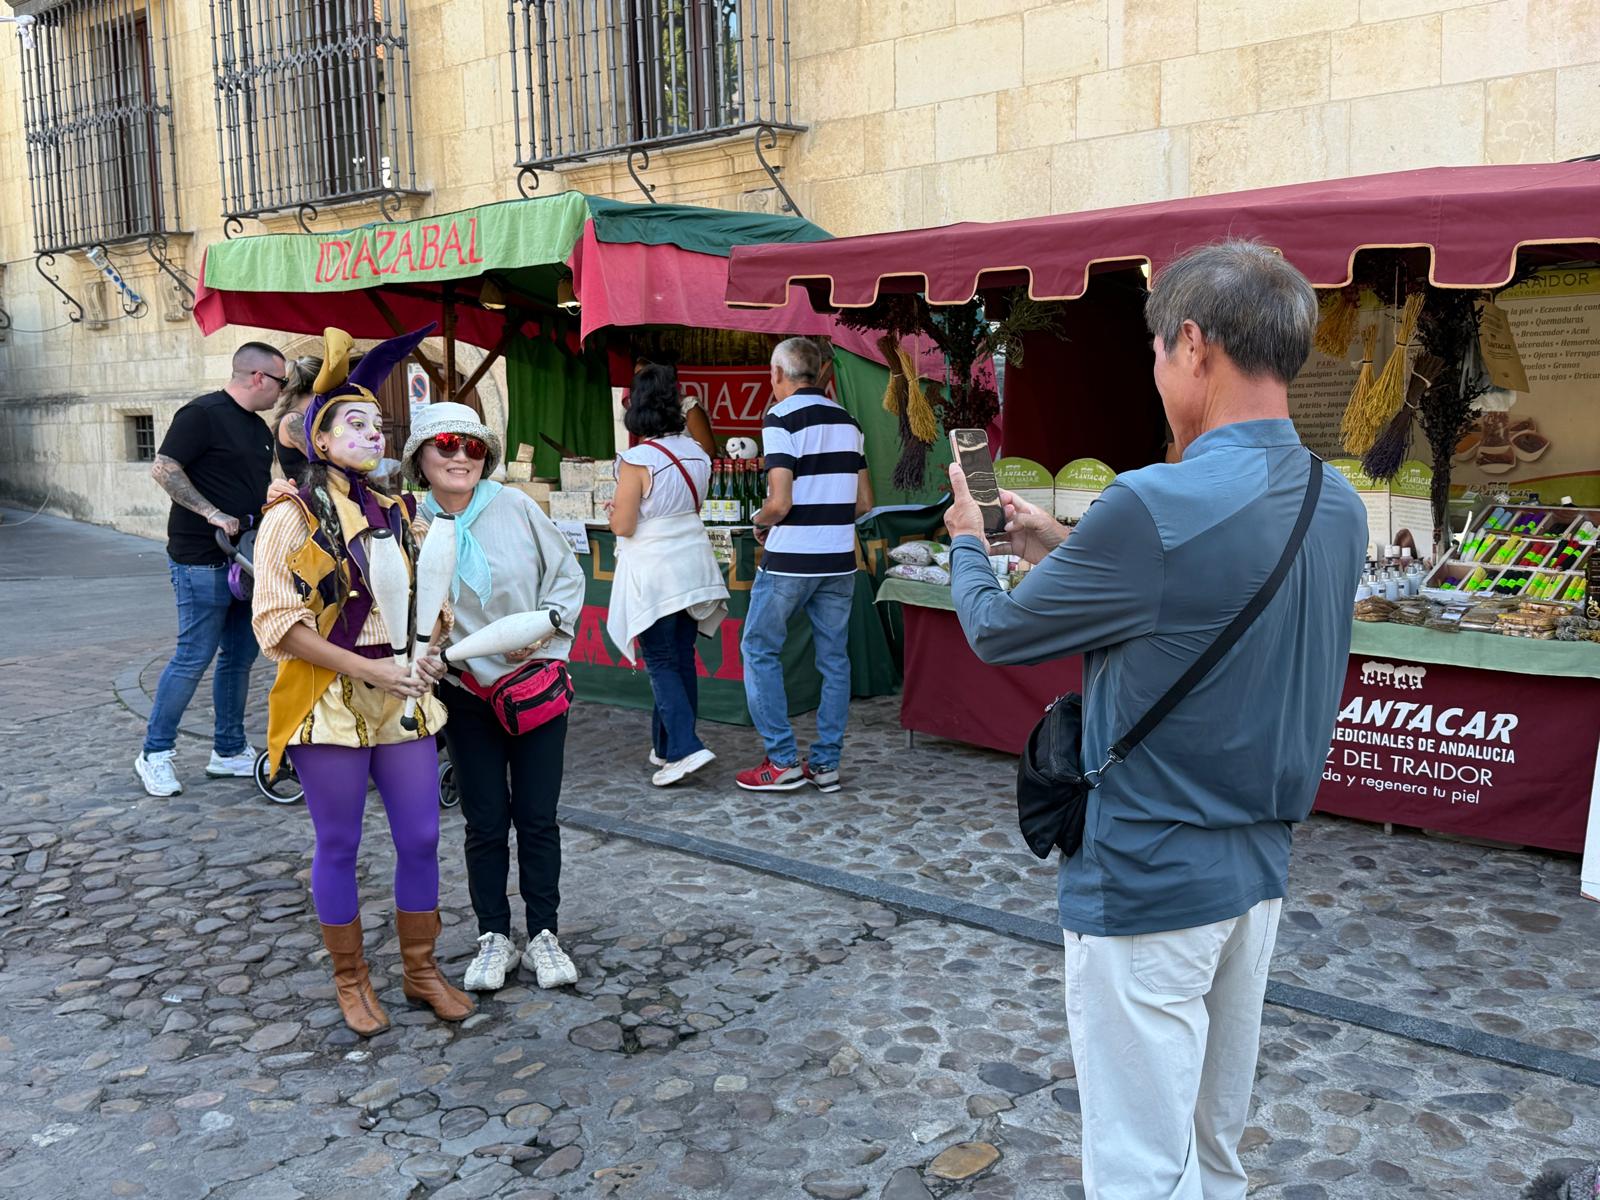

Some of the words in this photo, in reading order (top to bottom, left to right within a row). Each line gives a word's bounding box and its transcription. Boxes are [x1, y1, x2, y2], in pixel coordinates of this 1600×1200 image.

[314, 217, 484, 284] IDIAZABAL
[1535, 316, 1585, 327] Quemaduras
[1418, 738, 1435, 753] DE
[1439, 741, 1516, 764] ANDALUCIA
[1343, 749, 1383, 771] DEL
[1390, 755, 1494, 787] TRAIDOR
[1346, 775, 1356, 787] y
[1361, 776, 1428, 796] regenera
[1433, 786, 1446, 799] tu
[1451, 790, 1481, 805] piel
